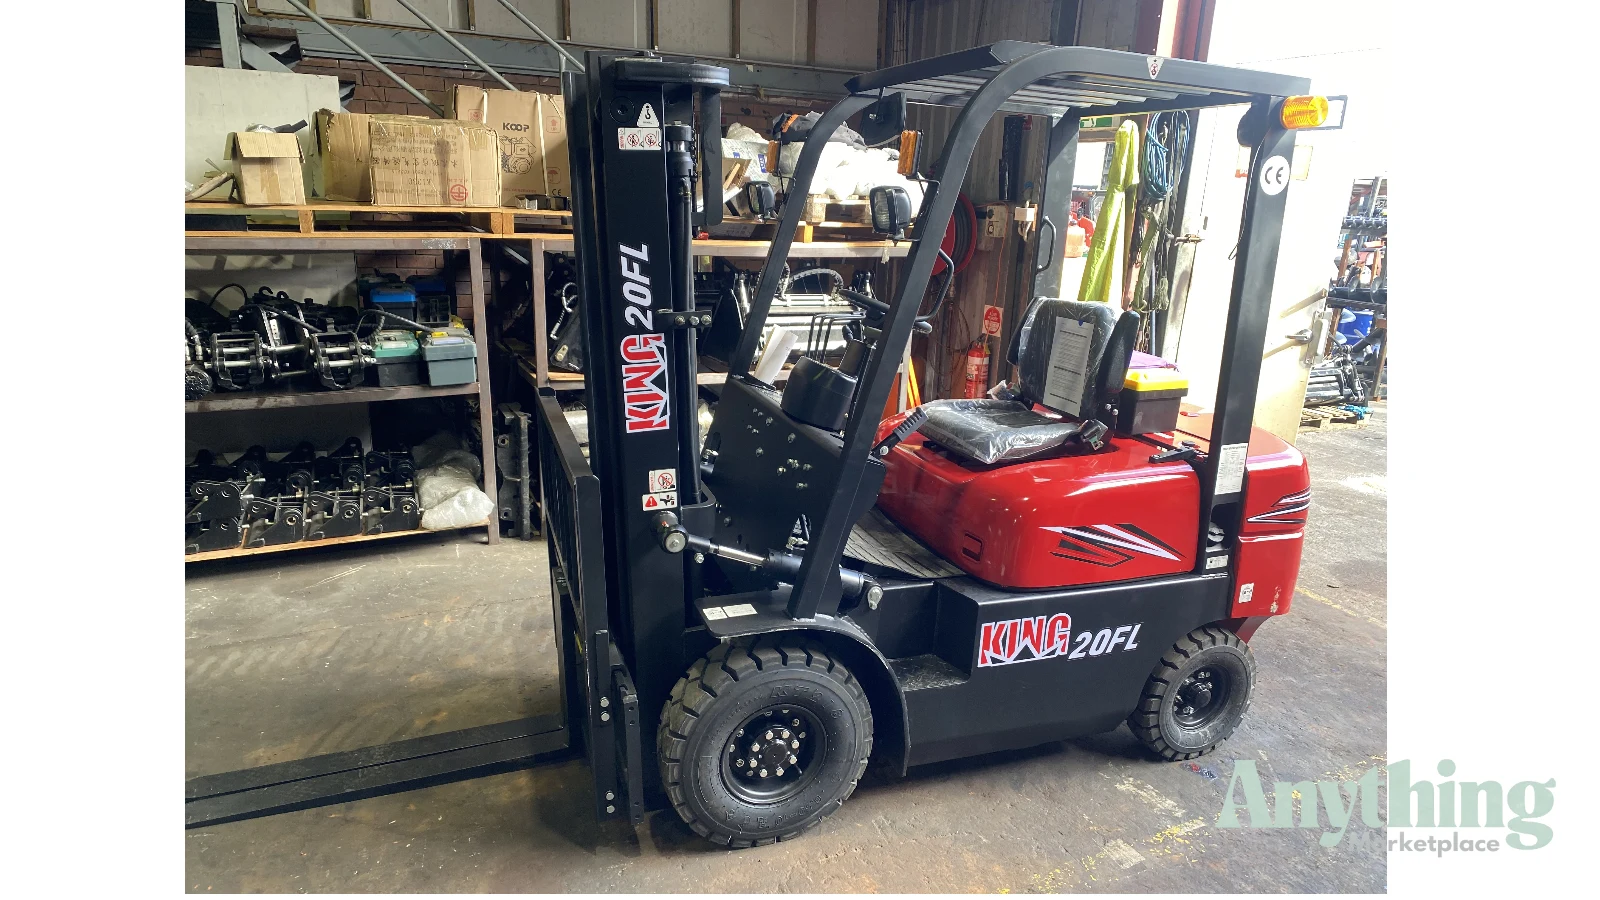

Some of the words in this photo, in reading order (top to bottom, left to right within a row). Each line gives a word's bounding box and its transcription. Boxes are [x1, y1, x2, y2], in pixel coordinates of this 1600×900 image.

[503, 122, 530, 132] KOOP
[1264, 166, 1284, 184] CE
[619, 242, 654, 331] 20FL
[620, 333, 671, 433] KING
[977, 613, 1072, 667] KING
[1068, 622, 1143, 661] 20FL
